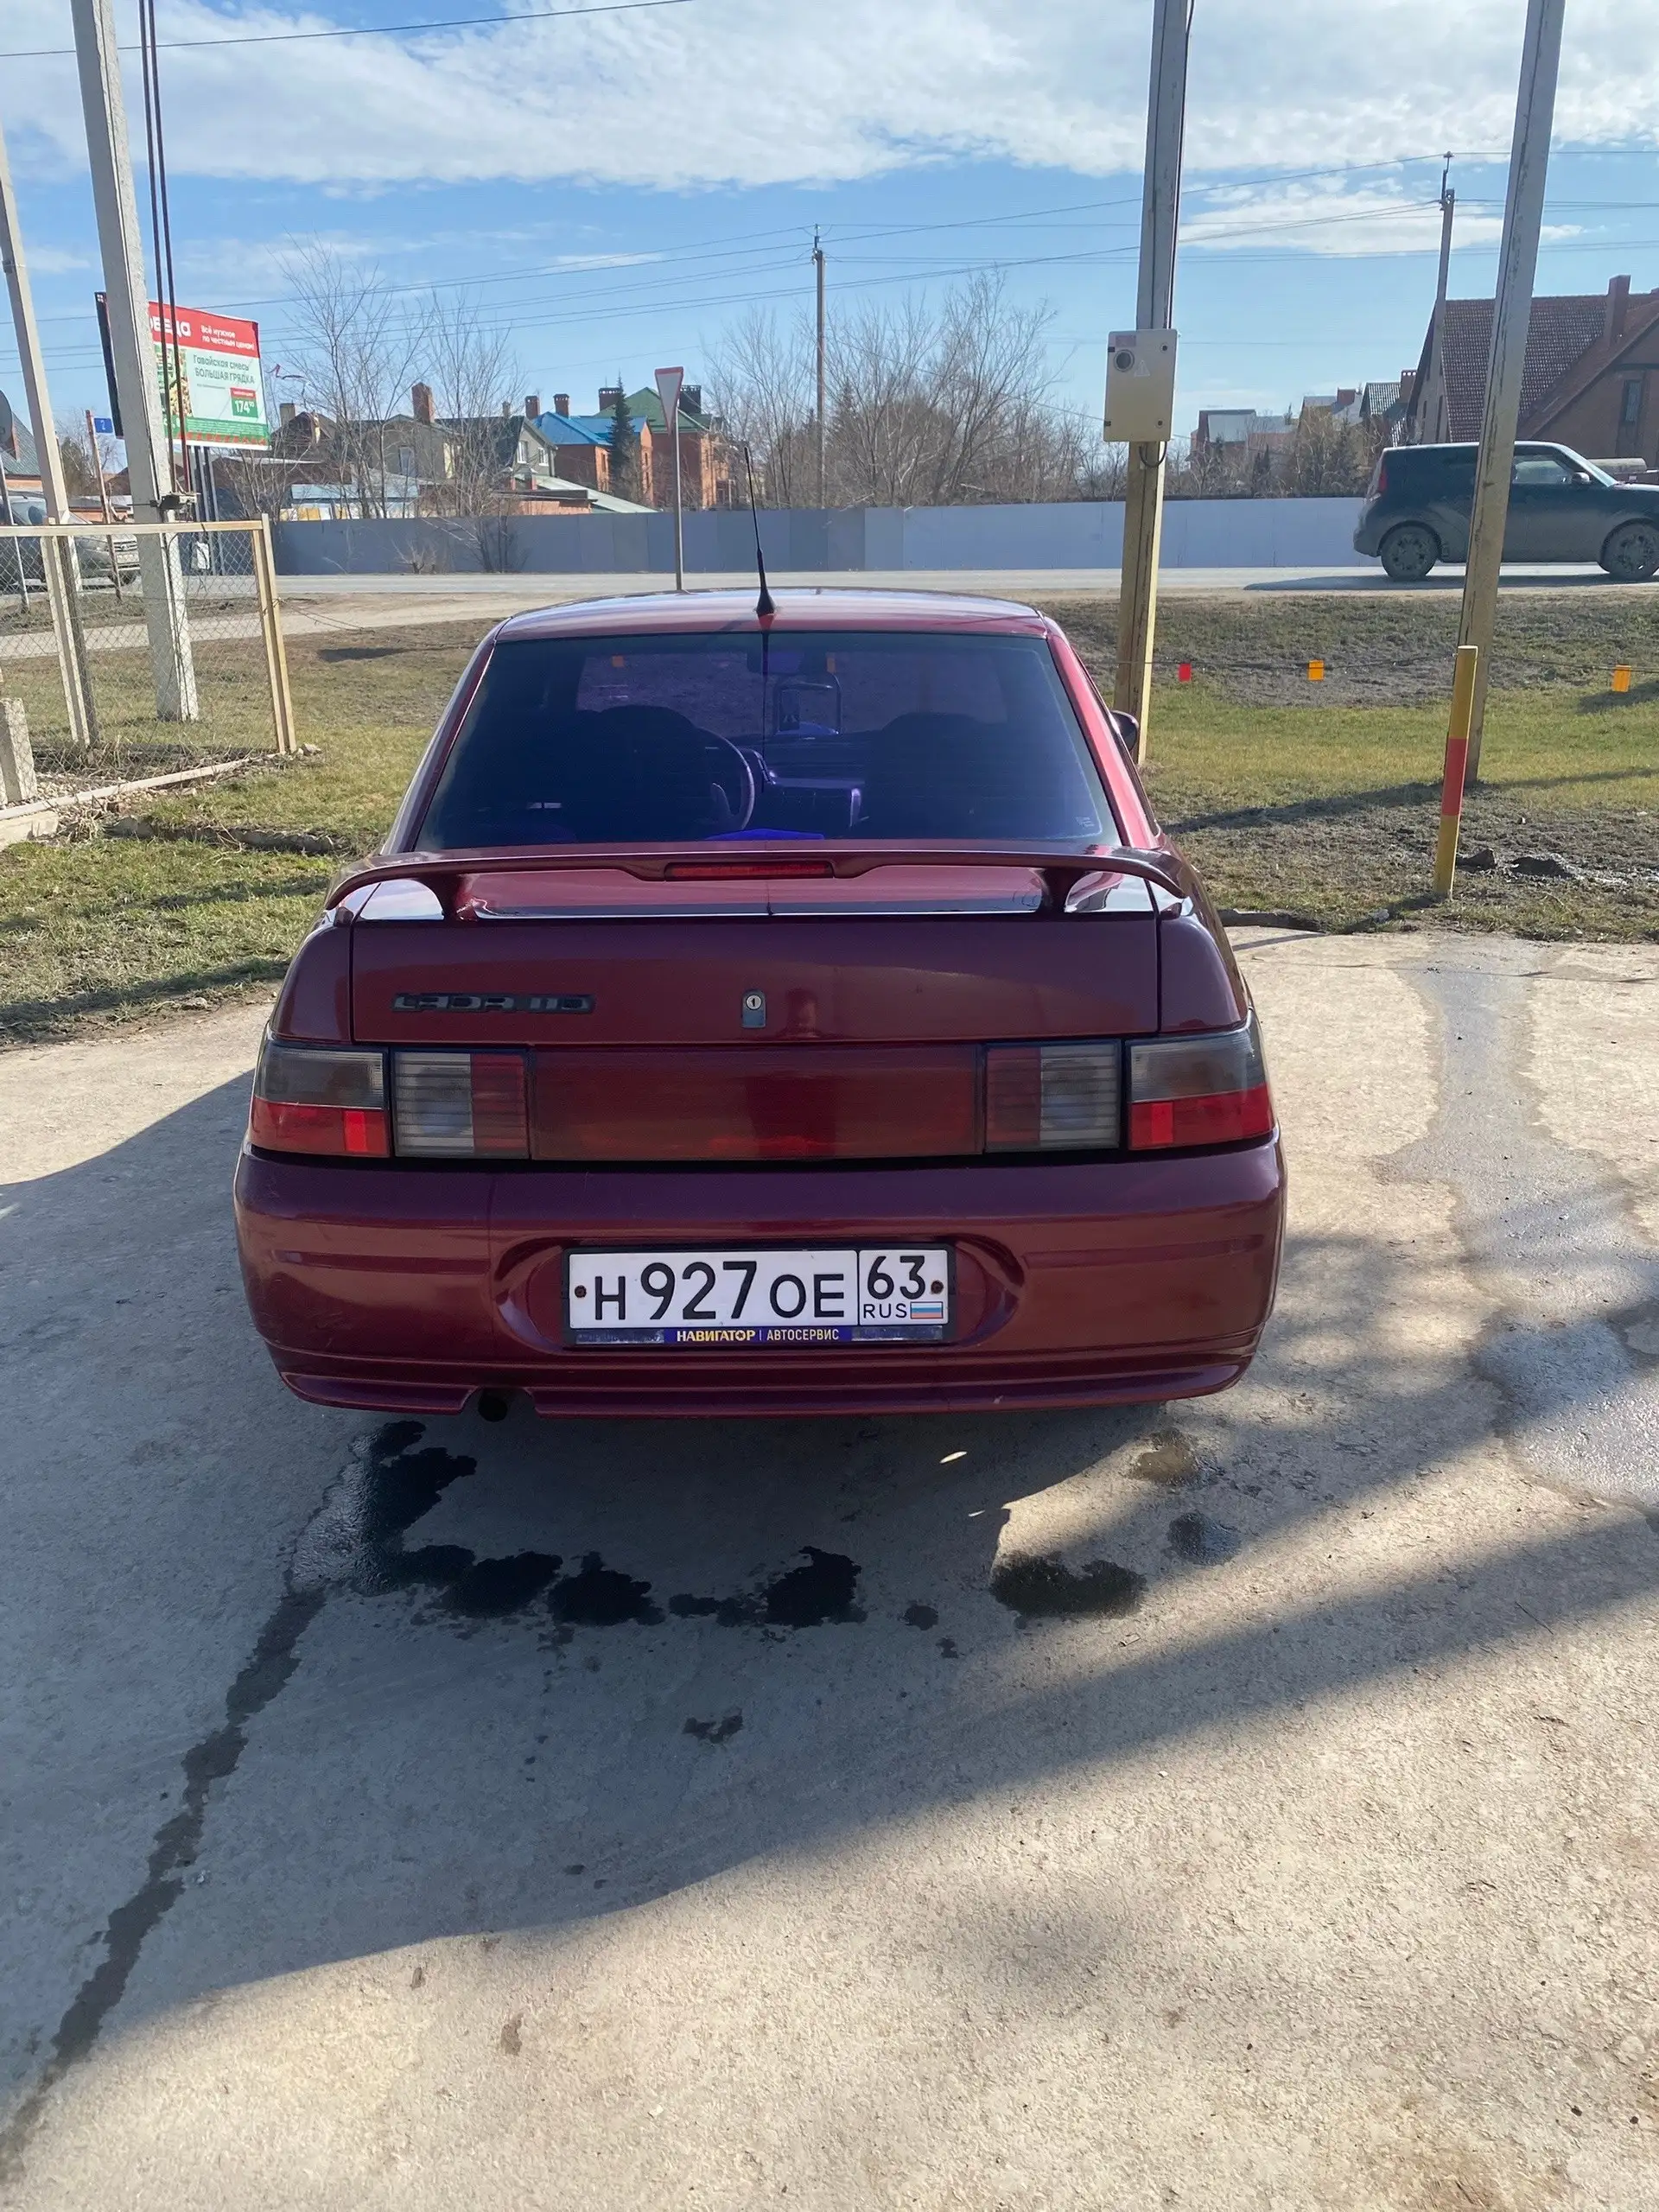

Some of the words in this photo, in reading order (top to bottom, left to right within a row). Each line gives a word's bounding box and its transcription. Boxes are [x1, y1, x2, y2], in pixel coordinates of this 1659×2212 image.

[229, 361, 249, 372] смесь
[195, 367, 229, 381] БОЛЬШАЯ
[229, 372, 255, 385] ГРЯДКА
[234, 400, 249, 414] 174
[393, 995, 516, 1010] LADA
[867, 1255, 926, 1300] 63
[863, 1303, 907, 1319] RUS
[677, 1330, 756, 1342] НАВИГАТОР
[766, 1328, 839, 1341] АВТОСЕРВИС
